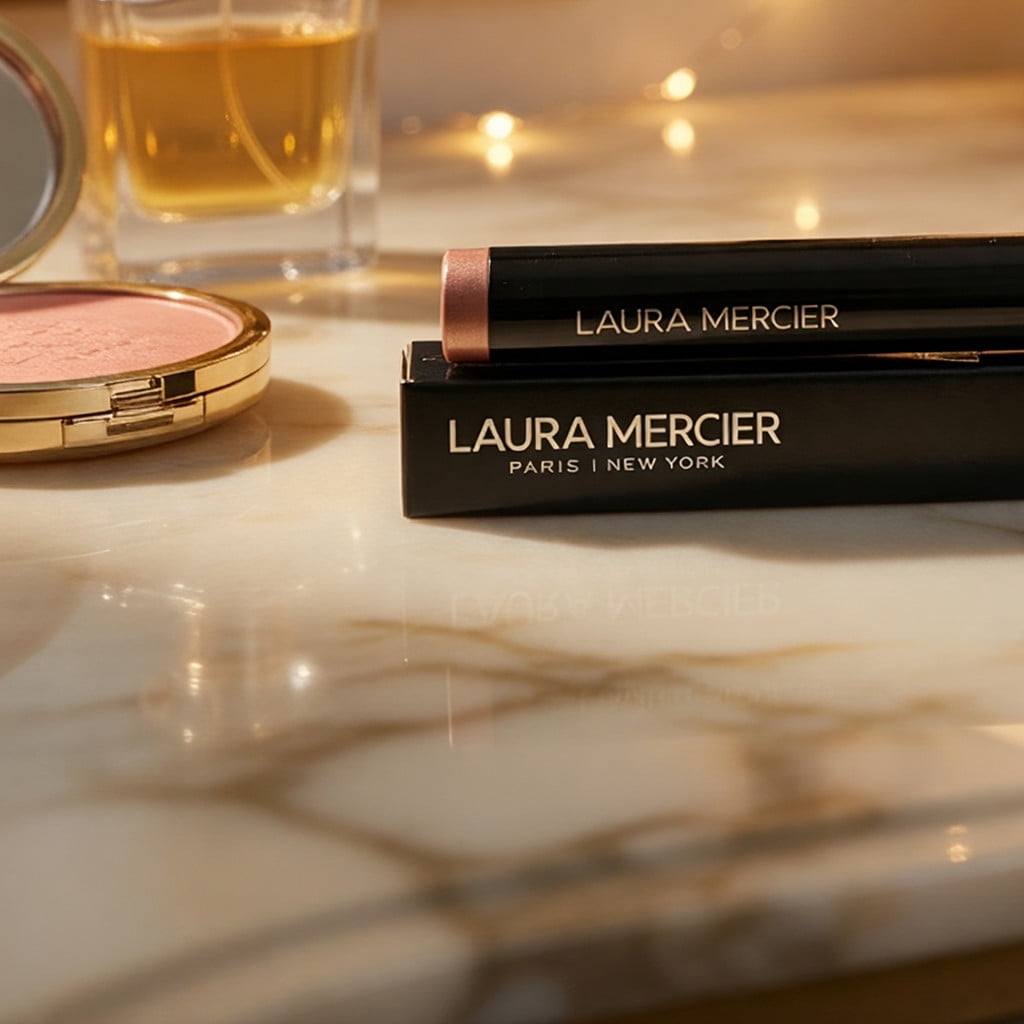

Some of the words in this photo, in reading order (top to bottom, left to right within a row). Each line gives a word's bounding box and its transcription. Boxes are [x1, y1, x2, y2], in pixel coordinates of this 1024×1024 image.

[576, 307, 692, 336] LAURA
[701, 304, 840, 332] MERCIER
[449, 416, 596, 453] LAURA
[606, 411, 782, 449] MERCIER
[509, 458, 580, 475] PARIS
[606, 456, 657, 473] NEW
[664, 454, 726, 470] YORK
